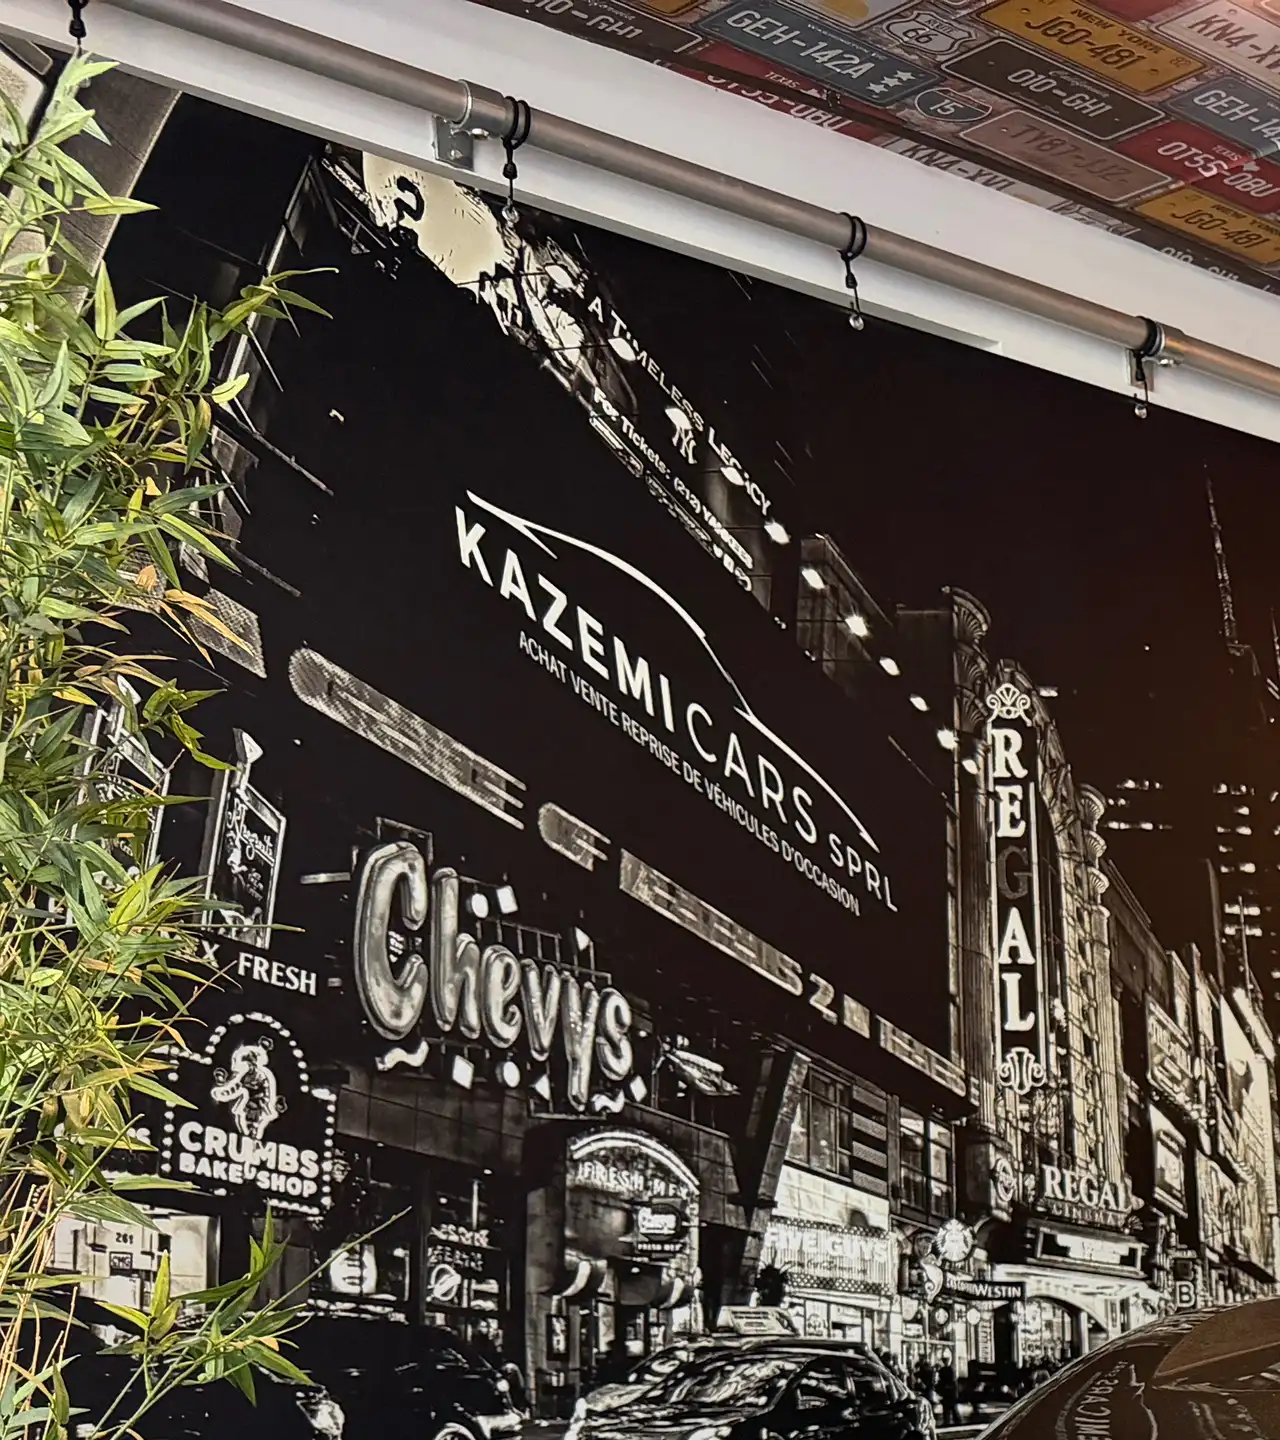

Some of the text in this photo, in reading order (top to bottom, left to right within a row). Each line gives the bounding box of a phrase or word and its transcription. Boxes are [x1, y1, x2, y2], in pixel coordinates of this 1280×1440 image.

[726, 11, 875, 80] GEH-142A
[903, 27, 939, 44] 66
[1071, 8, 1159, 54] NEW YORK
[764, 71, 800, 89] TEXAS
[929, 100, 963, 115] 15
[588, 296, 604, 323] A
[455, 505, 675, 733] KAZEMI
[686, 702, 818, 845] CARS
[828, 832, 899, 913] SPRL
[519, 630, 861, 918] ACHAT VENTE REPRISE DE VÉHICULES D'OCCASION
[991, 727, 1036, 1033] REGAL
[238, 952, 317, 996] FRESH
[353, 841, 633, 1112] Chevys
[178, 1122, 320, 1179] CRUMBS
[178, 1152, 318, 1198] BAKE SHOP
[1042, 1163, 1132, 1212] REGAL
[764, 1227, 819, 1253] FIVE
[831, 1237, 889, 1267] GUYS
